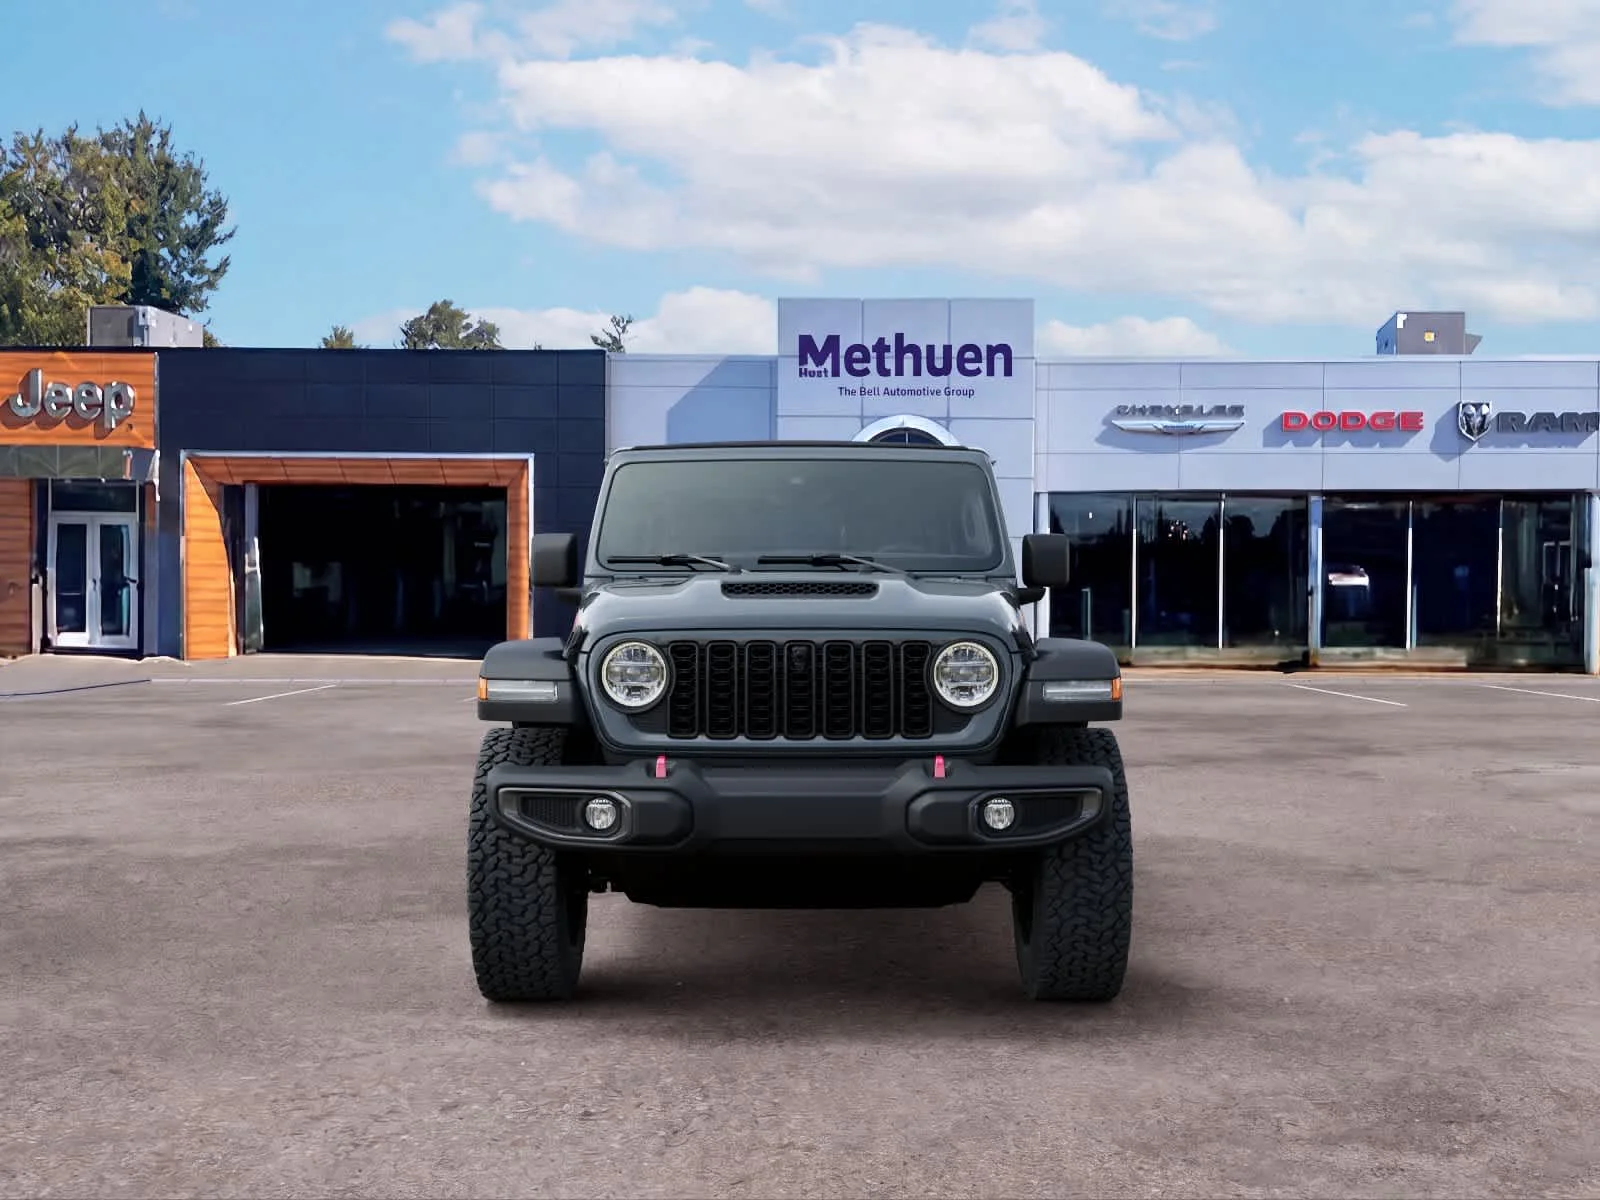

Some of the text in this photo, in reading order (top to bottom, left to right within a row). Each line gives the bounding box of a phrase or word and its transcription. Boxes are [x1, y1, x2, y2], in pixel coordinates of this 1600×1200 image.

[798, 332, 1013, 377] Methuen
[9, 367, 136, 429] Jeep
[838, 386, 975, 399] The Bell Automotive Group
[1282, 411, 1424, 432] DODGE
[1497, 411, 1600, 433] RAM
